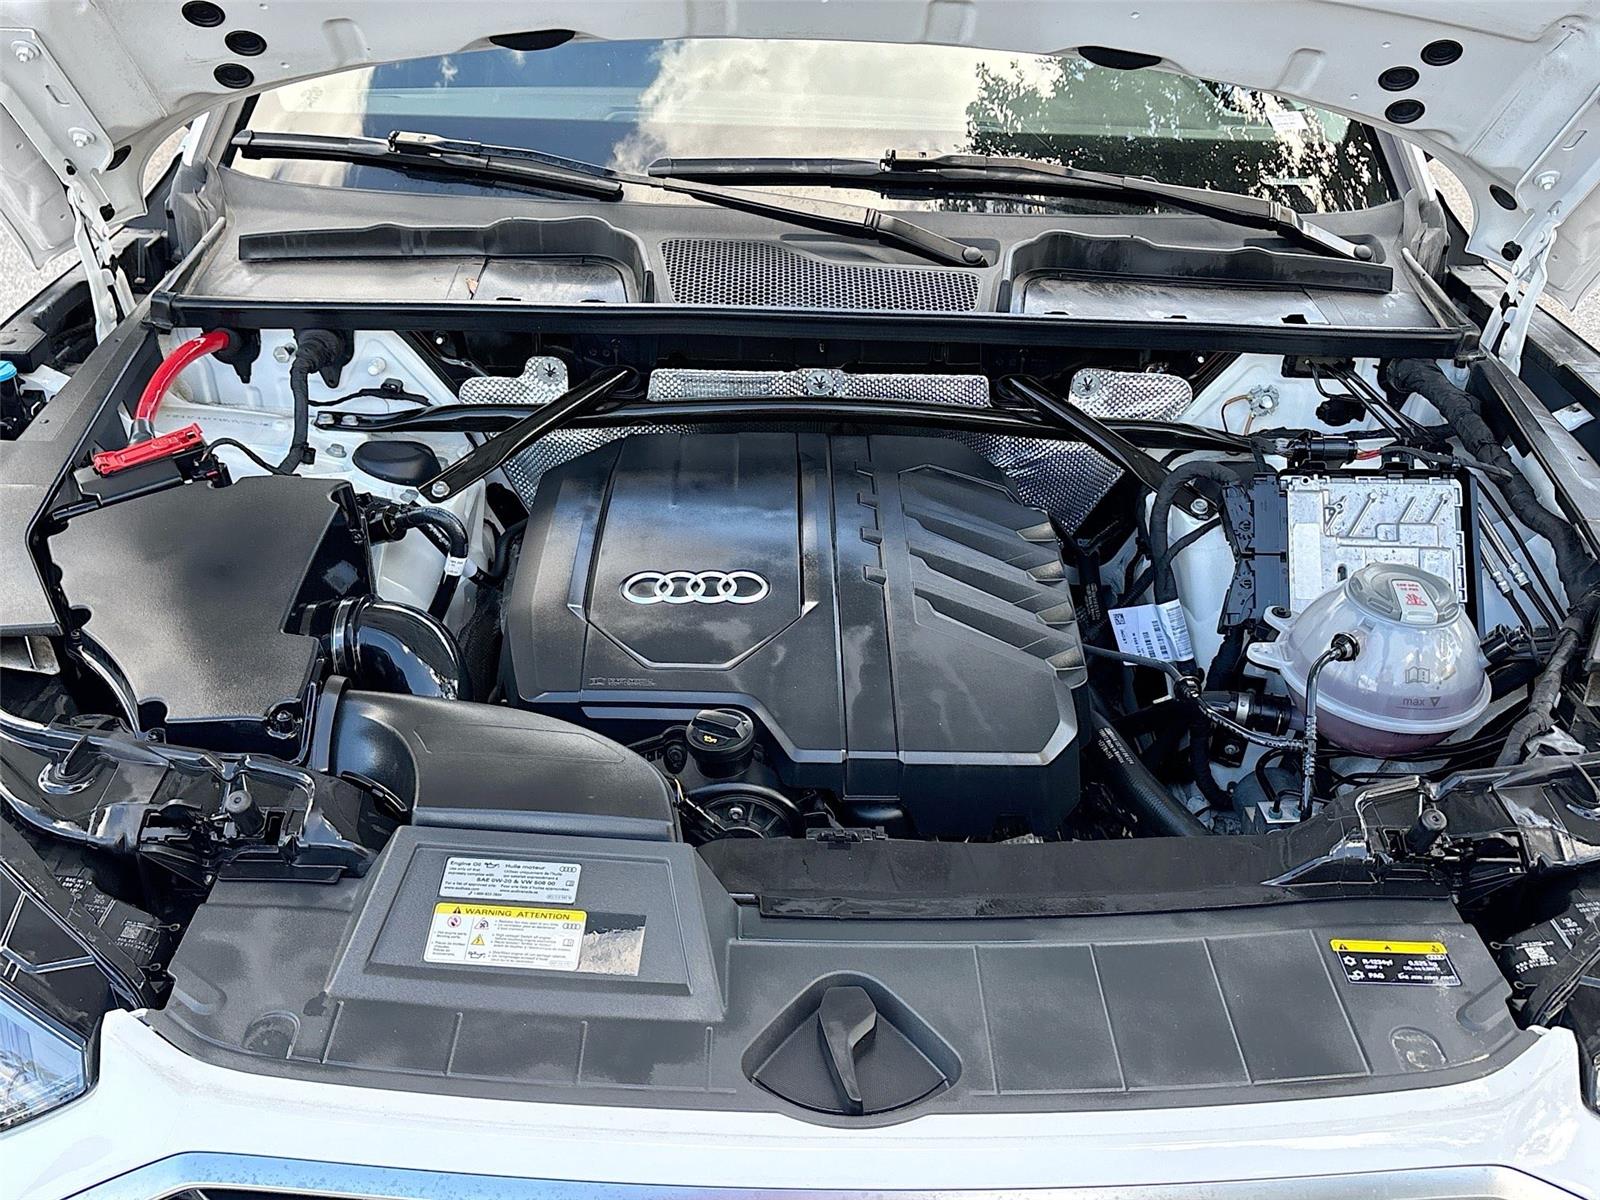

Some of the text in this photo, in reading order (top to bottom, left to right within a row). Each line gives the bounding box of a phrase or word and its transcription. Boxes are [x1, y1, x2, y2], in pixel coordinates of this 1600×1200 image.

[1402, 697, 1425, 706] max
[465, 908, 570, 920] WARNING ATTENTION
